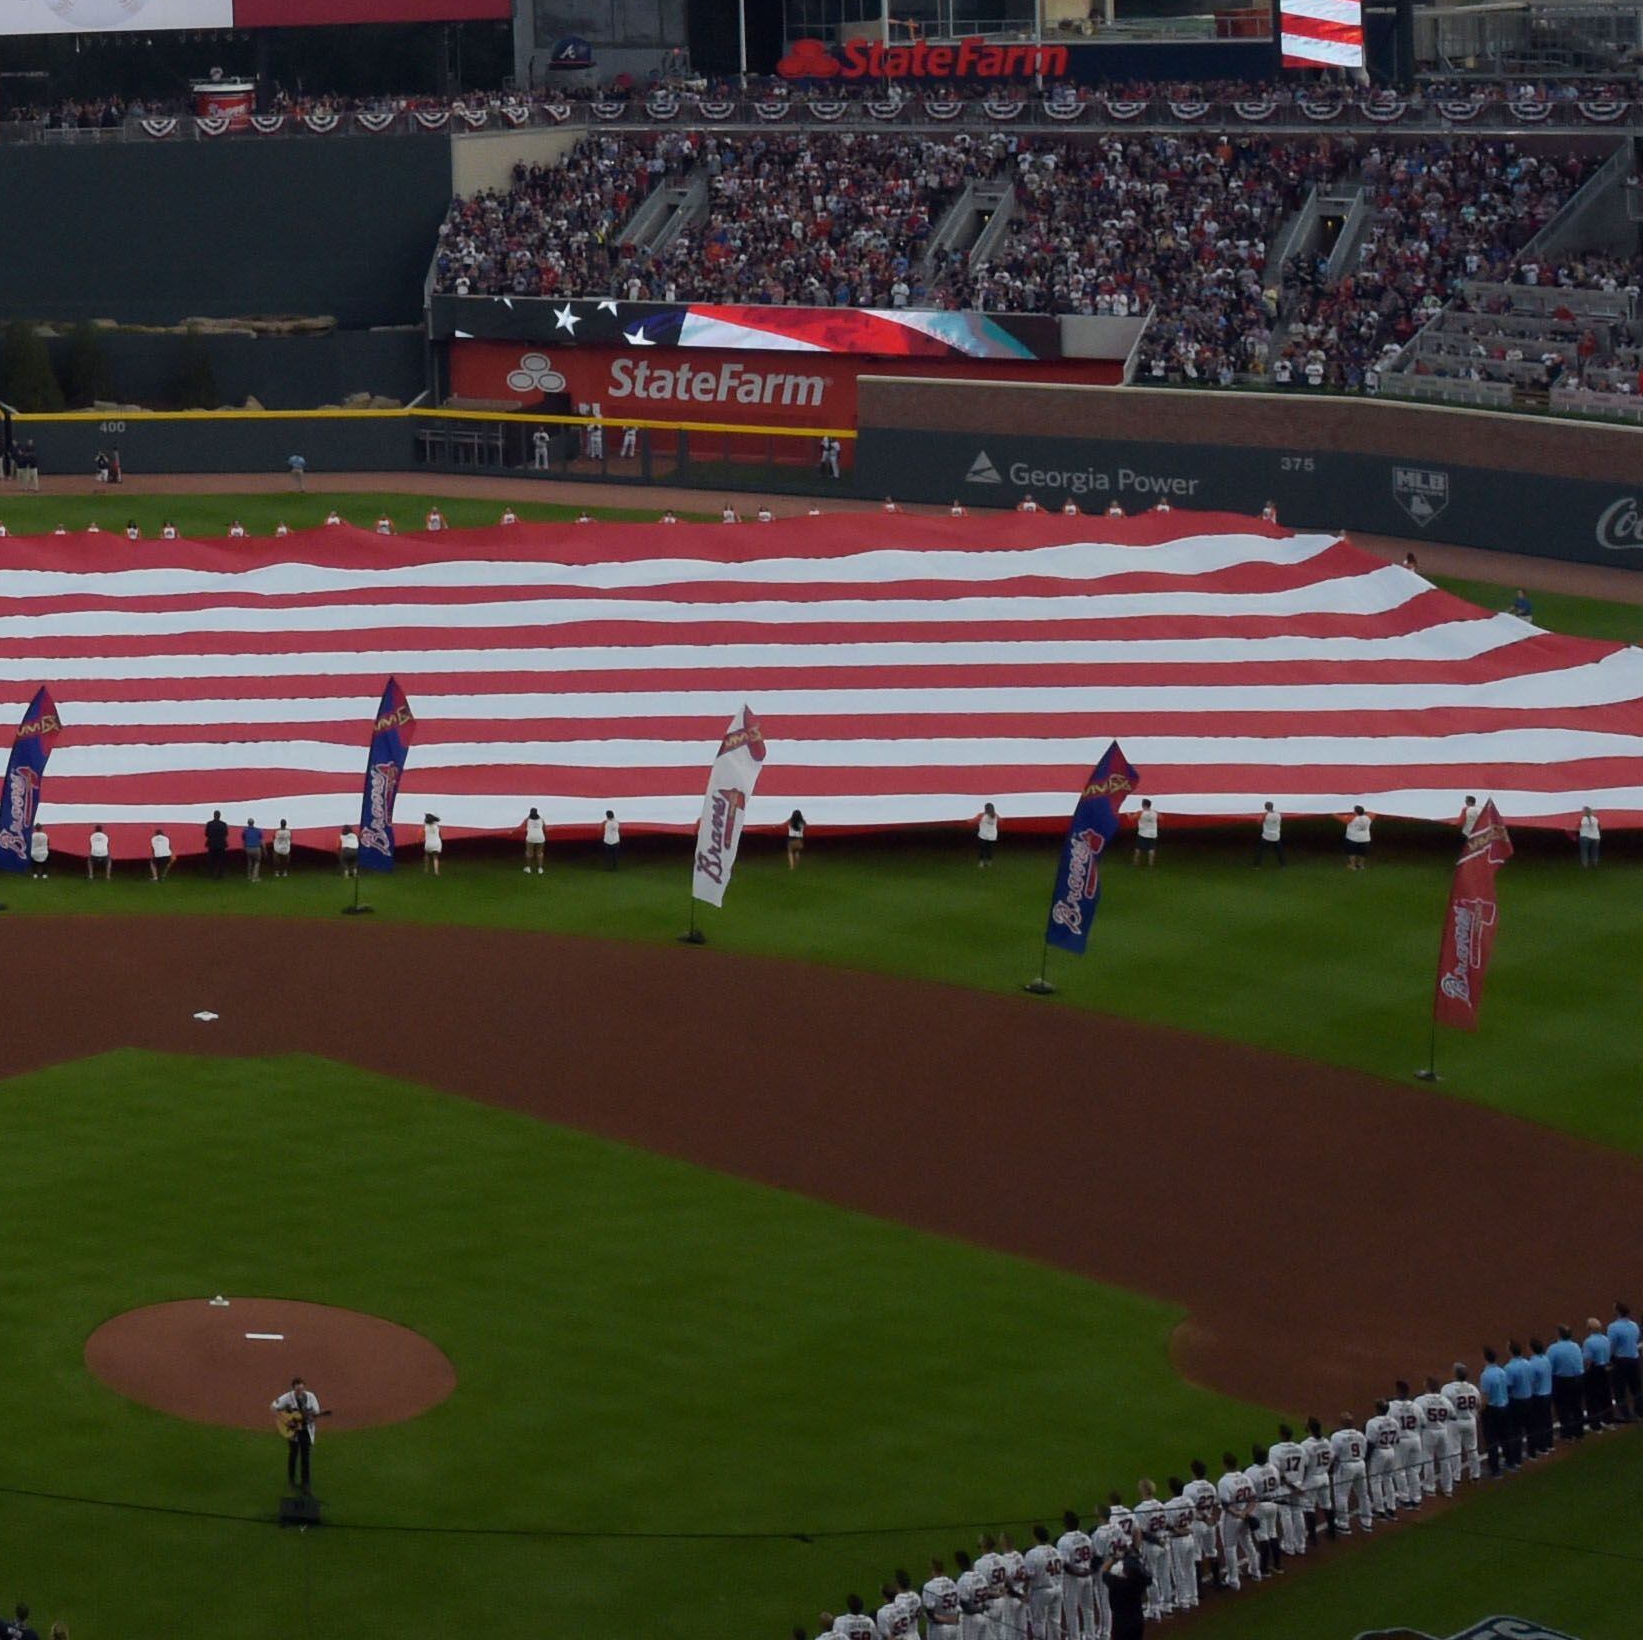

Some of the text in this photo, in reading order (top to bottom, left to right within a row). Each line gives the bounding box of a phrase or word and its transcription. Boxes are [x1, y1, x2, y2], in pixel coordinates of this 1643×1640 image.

[100, 422, 125, 432] 400
[1281, 457, 1315, 471] 375
[1010, 463, 1199, 496] Georgia Power
[1397, 471, 1445, 490] MLB
[698, 797, 726, 884] Braves
[1053, 834, 1091, 935] Braves
